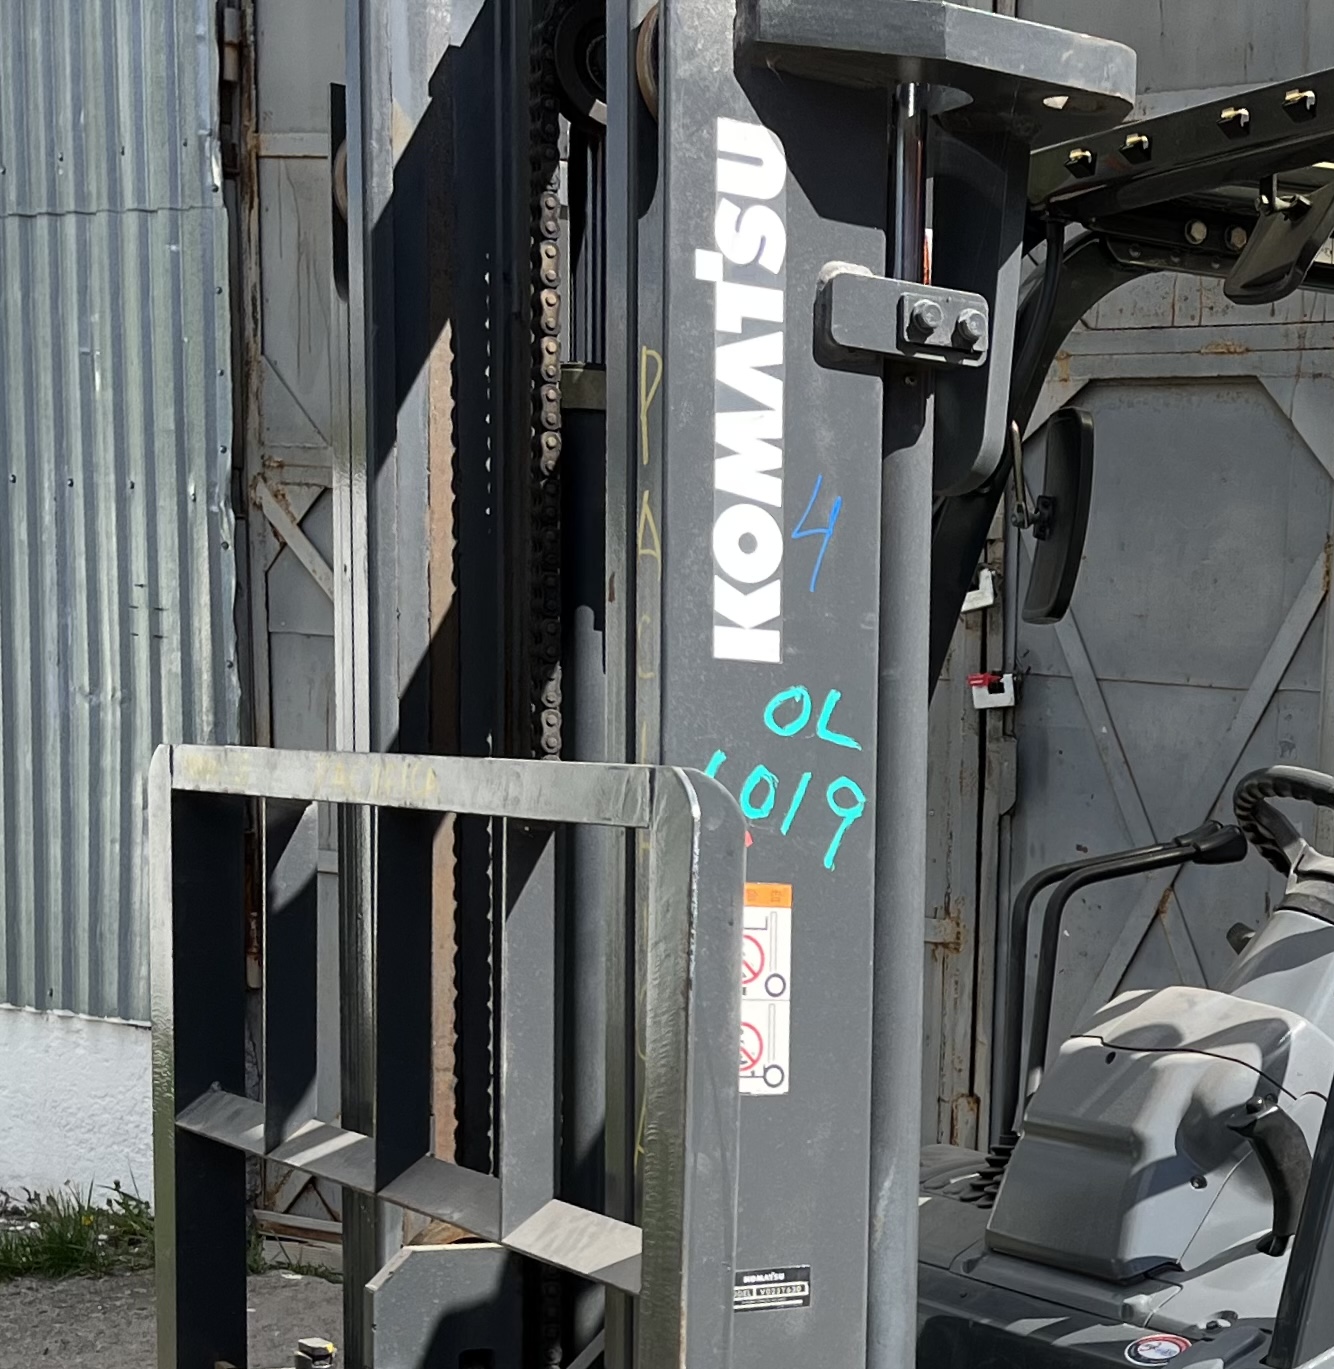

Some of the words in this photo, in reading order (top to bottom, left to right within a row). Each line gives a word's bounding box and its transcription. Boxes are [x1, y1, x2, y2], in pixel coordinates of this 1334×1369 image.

[695, 116, 787, 664] KOMATSU
[791, 474, 842, 592] 4
[763, 684, 863, 751] OL
[743, 1272, 785, 1283] KOMATSU
